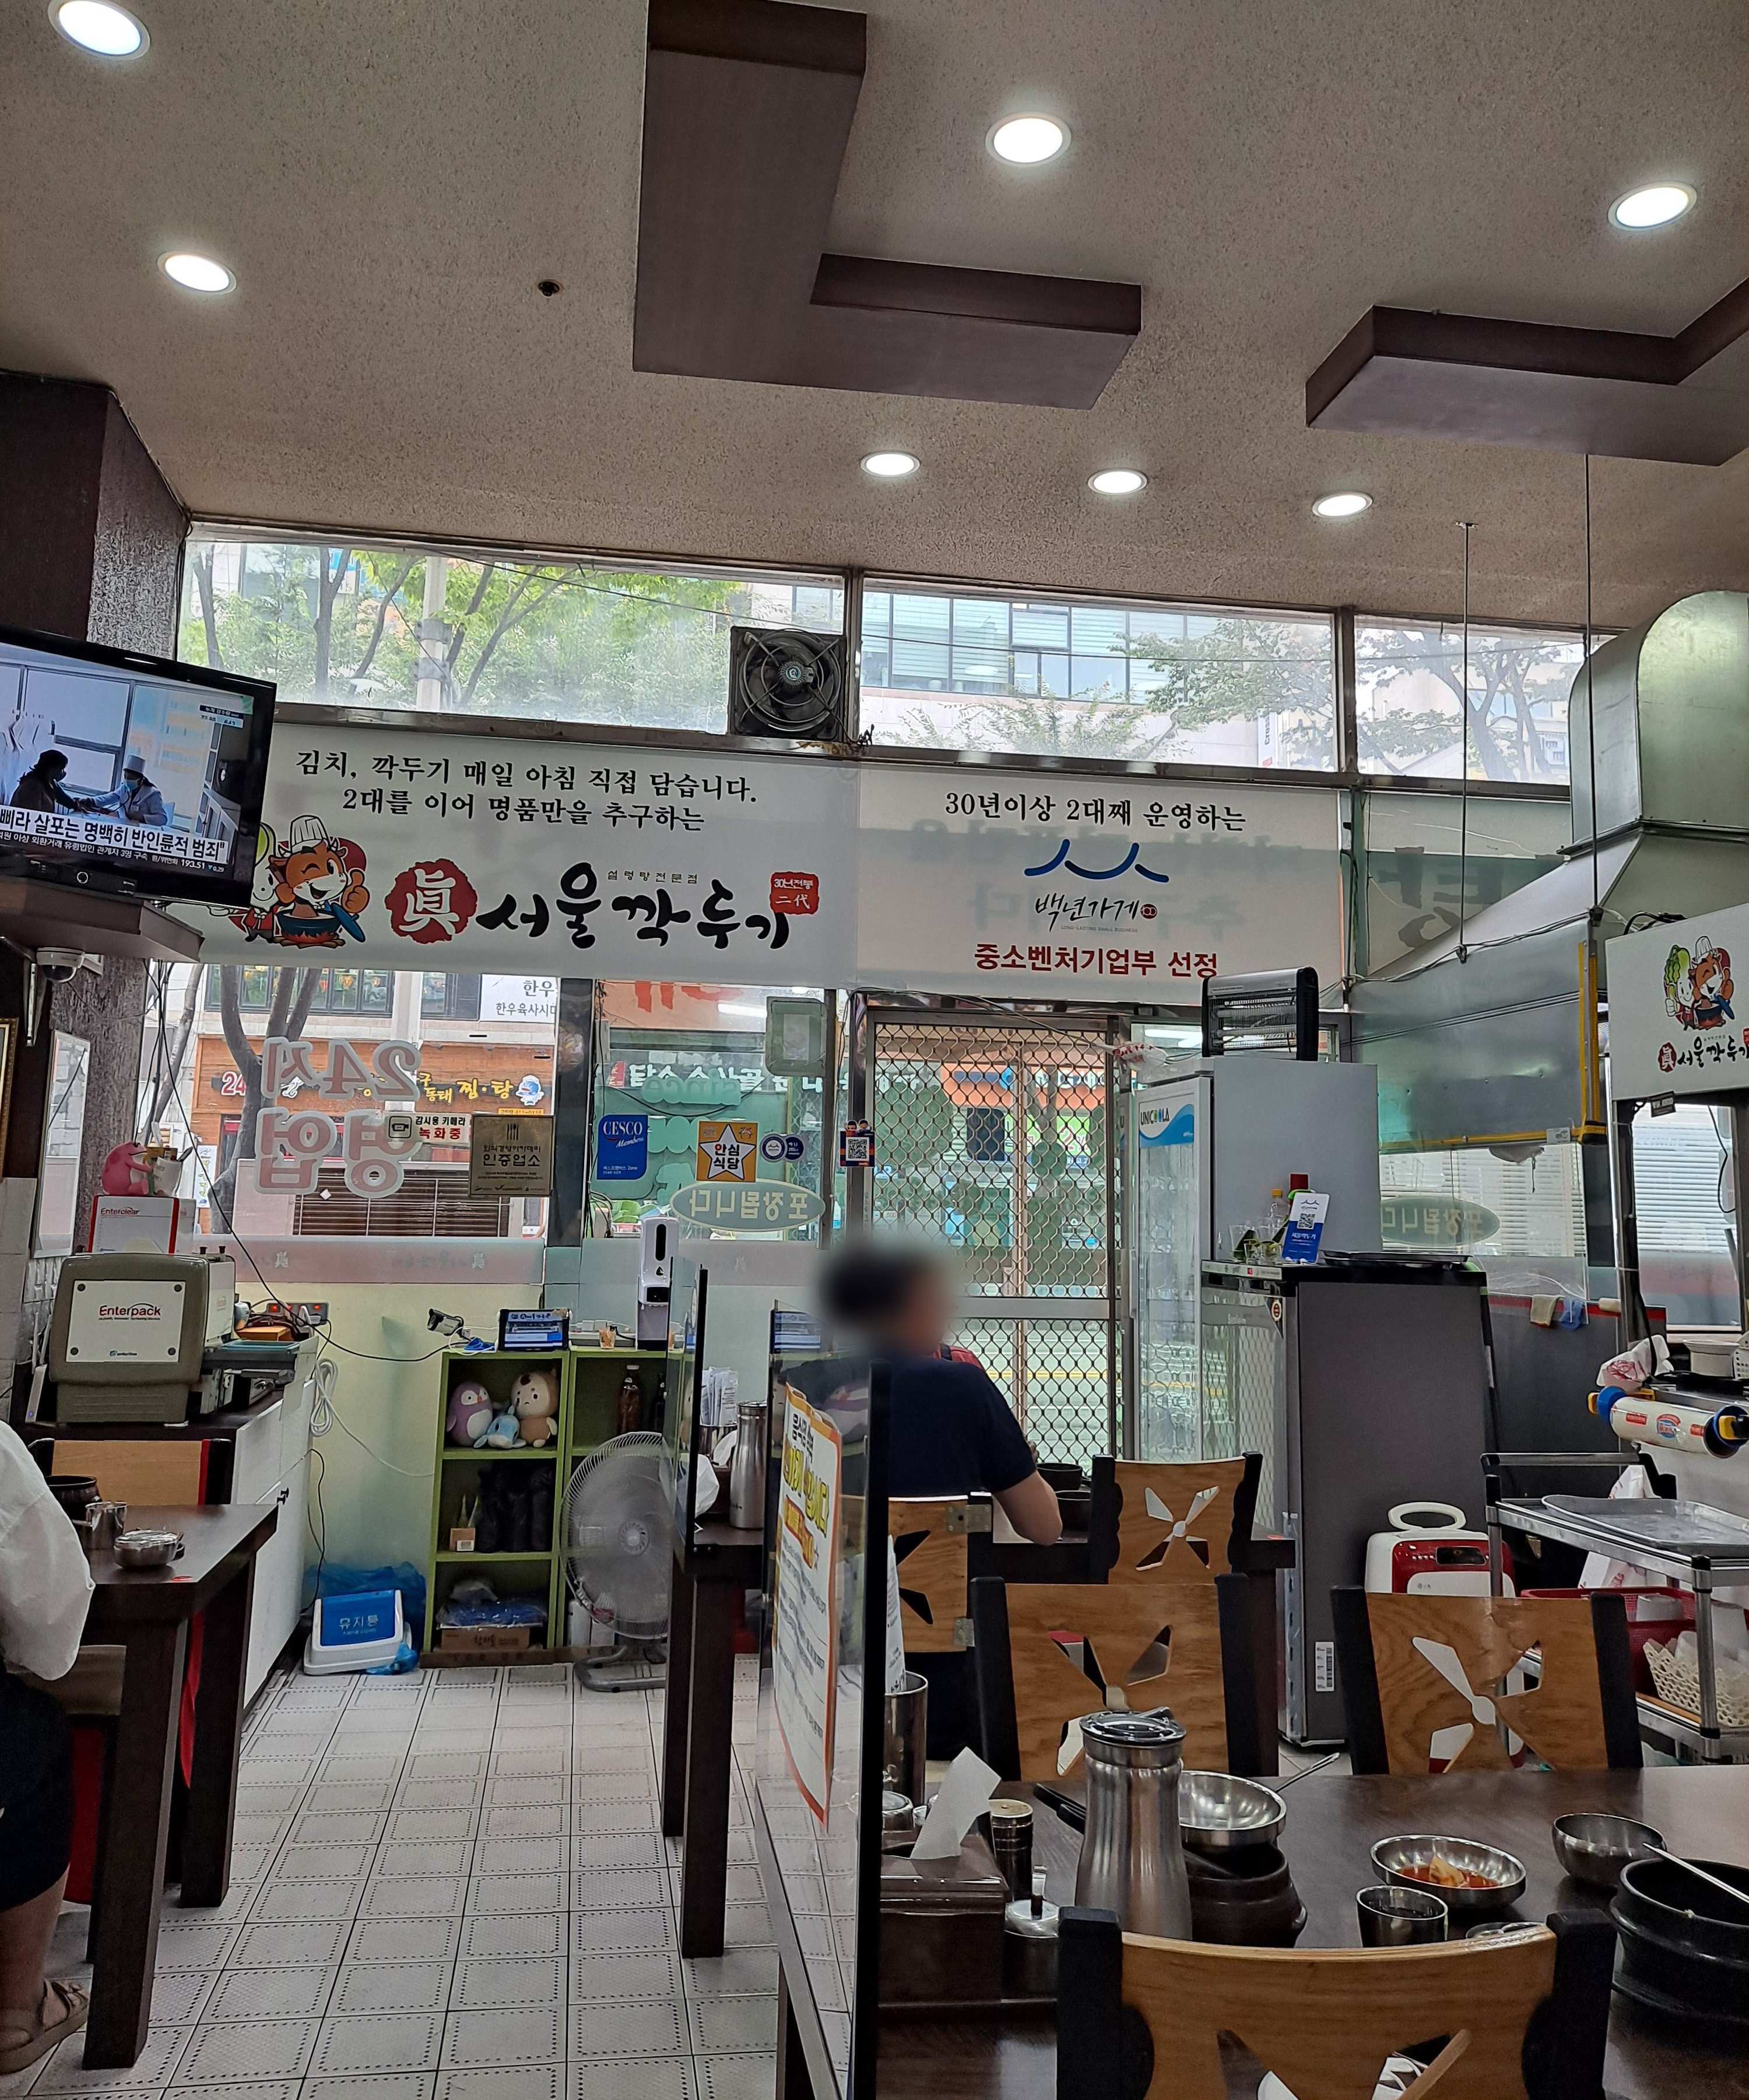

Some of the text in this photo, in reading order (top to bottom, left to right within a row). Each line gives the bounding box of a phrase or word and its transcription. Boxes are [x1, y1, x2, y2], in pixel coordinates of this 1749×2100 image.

[296, 750, 757, 803] 김치, 깍두기 매일 아침 직접 담습니다.
[342, 788, 705, 831] 2대를 이어 명품만을 추구하는
[944, 792, 1247, 832] 30년이상 2대째 운영하는
[34, 814, 80, 839] 살포는
[85, 822, 128, 846] 명백히
[131, 829, 189, 856] 반인륜적
[13, 833, 30, 843] 이상
[134, 852, 148, 861] 구속
[774, 878, 814, 889] 30년전통
[1035, 892, 1140, 933] 백년가게
[974, 943, 1218, 979] 중소벤처기업부 선정
[416, 1116, 439, 1125] 감시용
[603, 1121, 643, 1135] CESCO
[483, 1154, 540, 1167] 인증업소
[715, 1144, 740, 1156] 안심
[713, 1157, 740, 1170] 식당
[99, 1304, 161, 1317] Enterpack
